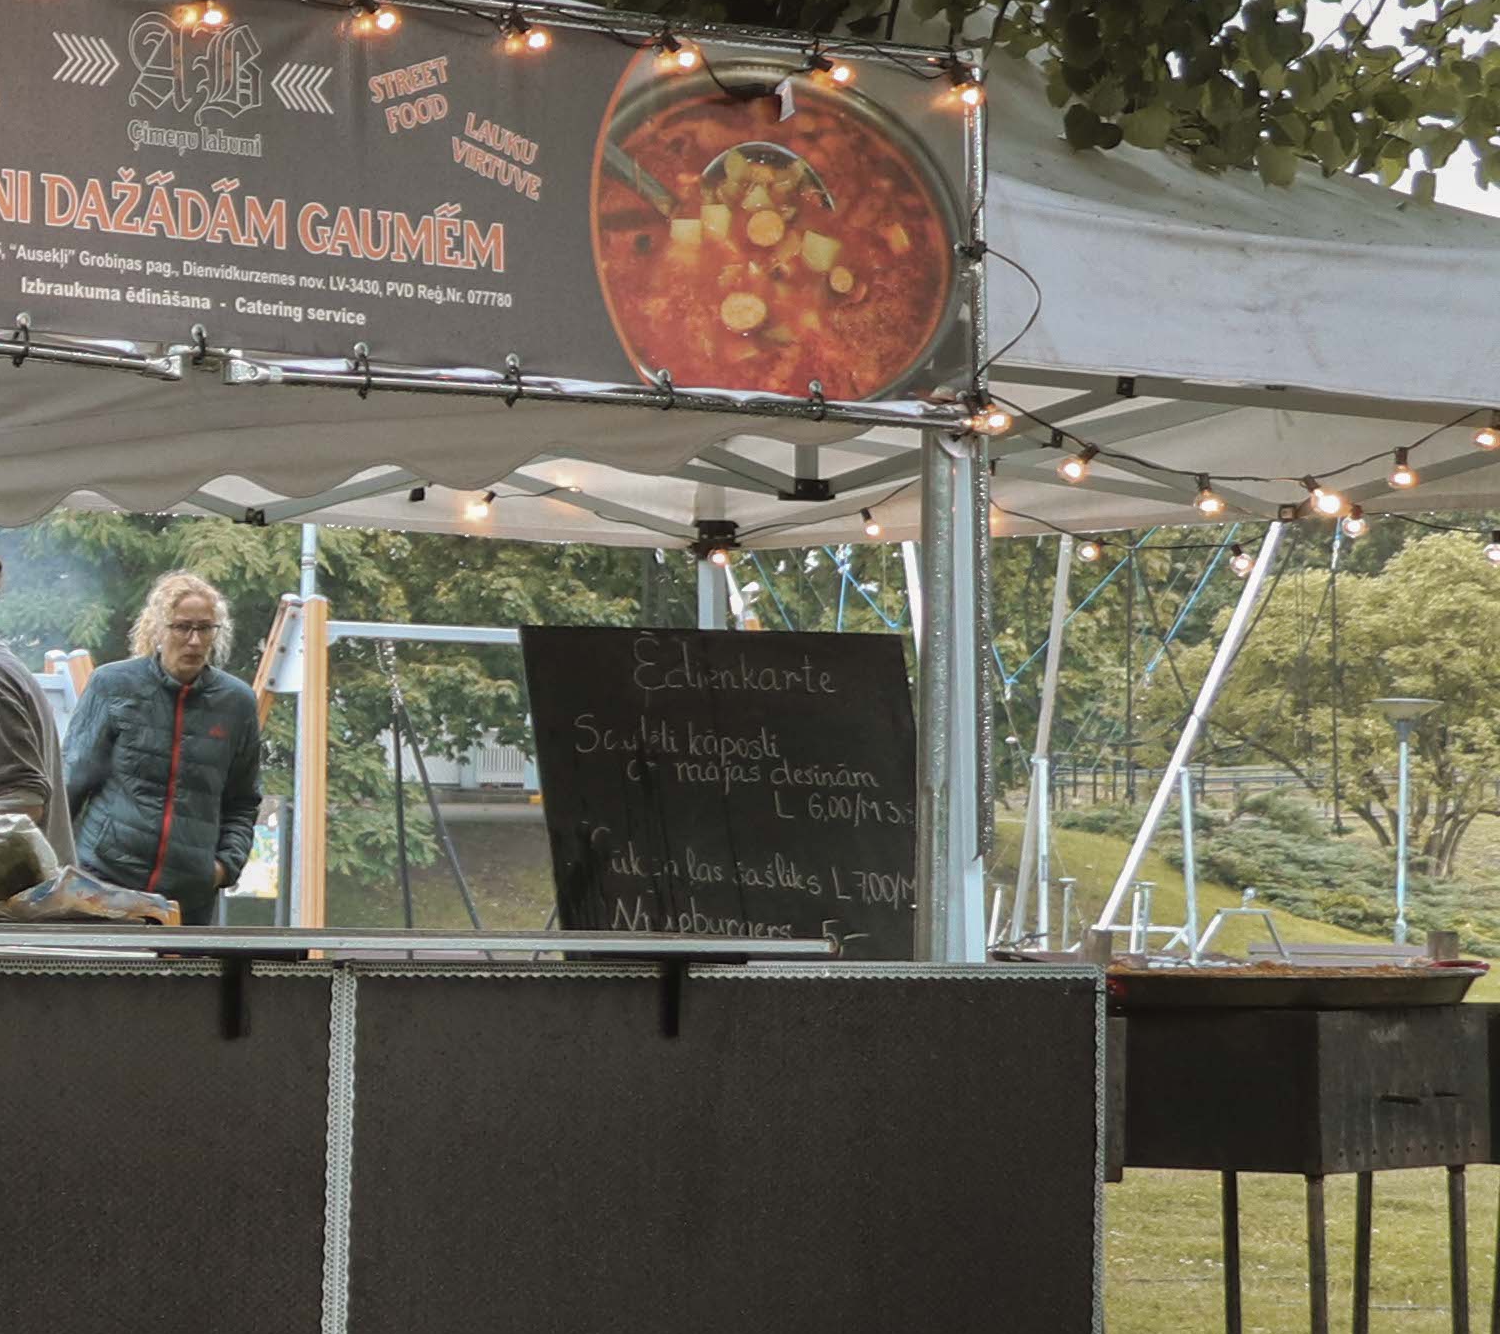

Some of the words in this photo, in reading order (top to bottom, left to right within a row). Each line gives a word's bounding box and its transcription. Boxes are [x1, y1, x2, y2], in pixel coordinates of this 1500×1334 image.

[368, 55, 449, 104] STREET
[384, 93, 449, 134] FOOD
[464, 111, 539, 165] LAUKU
[127, 119, 198, 156] Ģimeņu
[200, 125, 262, 158] labumi
[451, 135, 542, 201] VIRTUVE
[40, 166, 287, 250] DAŽĀDĀM
[297, 202, 505, 273] GAUMĒM
[21, 277, 121, 302] Izbraukuma
[126, 284, 212, 310] ēdināšana
[235, 296, 303, 322] Catering
[306, 305, 366, 326] service
[79, 250, 142, 274] Grobiņas
[183, 260, 296, 287] Dienvidkurzemes
[299, 275, 326, 291] nov.
[329, 276, 383, 298] LV-3430,
[386, 281, 414, 298] PVD
[467, 289, 513, 308] 077780
[773, 791, 794, 819] L
